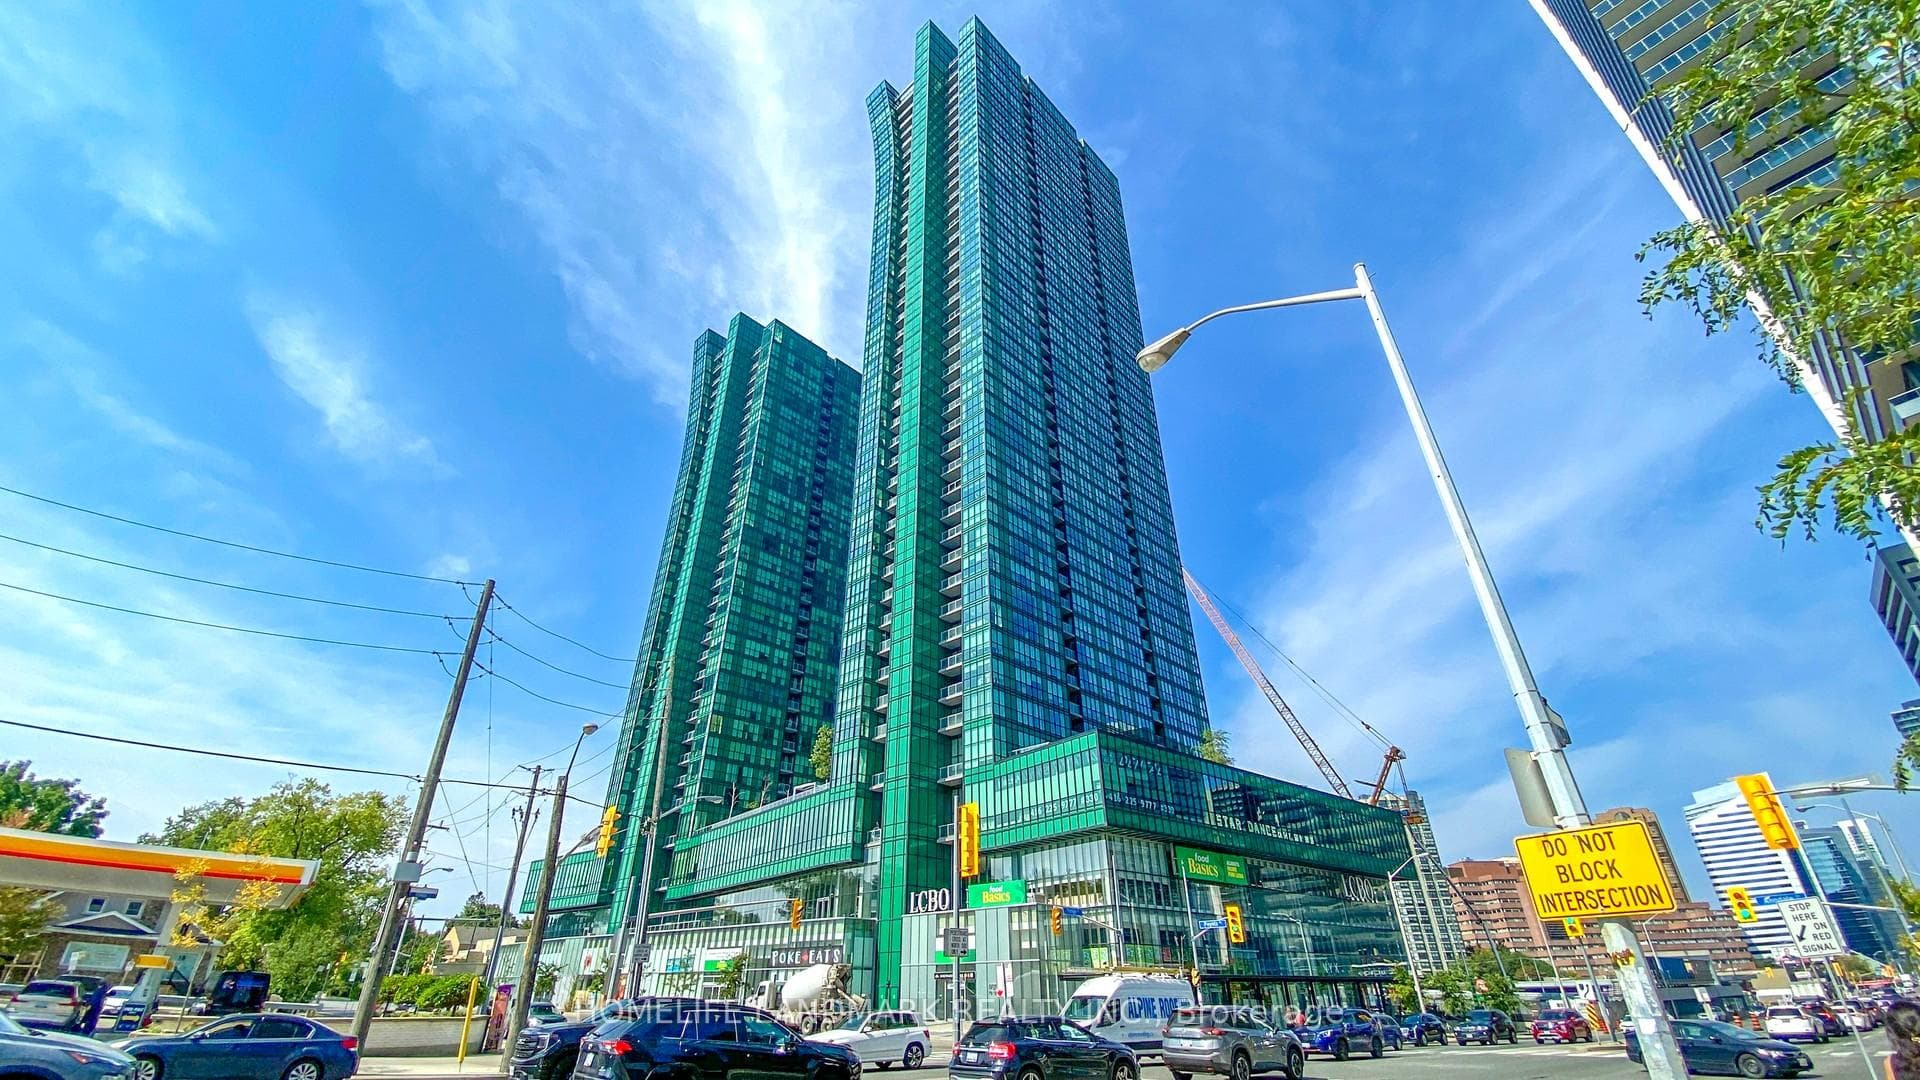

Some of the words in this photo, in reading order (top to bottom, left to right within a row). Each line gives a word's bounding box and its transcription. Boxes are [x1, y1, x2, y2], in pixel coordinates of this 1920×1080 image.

[1045, 802, 1058, 814] 225
[1216, 813, 1242, 831] STAR
[1542, 837, 1567, 858] DO
[1575, 831, 1616, 854] NOT
[1194, 852, 1210, 863] food
[1188, 857, 1219, 878] Basics
[1556, 858, 1623, 884] BLOCK
[989, 885, 1004, 893] food
[909, 887, 950, 914] LCBO
[981, 891, 1011, 904] Basics
[1538, 883, 1665, 913] INTERSECTION
[1788, 902, 1811, 912] STOP
[1792, 911, 1818, 922] HERE
[1813, 921, 1828, 931] ON
[1812, 932, 1832, 942] RED
[1801, 942, 1837, 953] SIGNAL
[771, 949, 801, 966] POKE
[808, 948, 842, 965] EATS
[1127, 996, 1157, 1019] ALPINE
